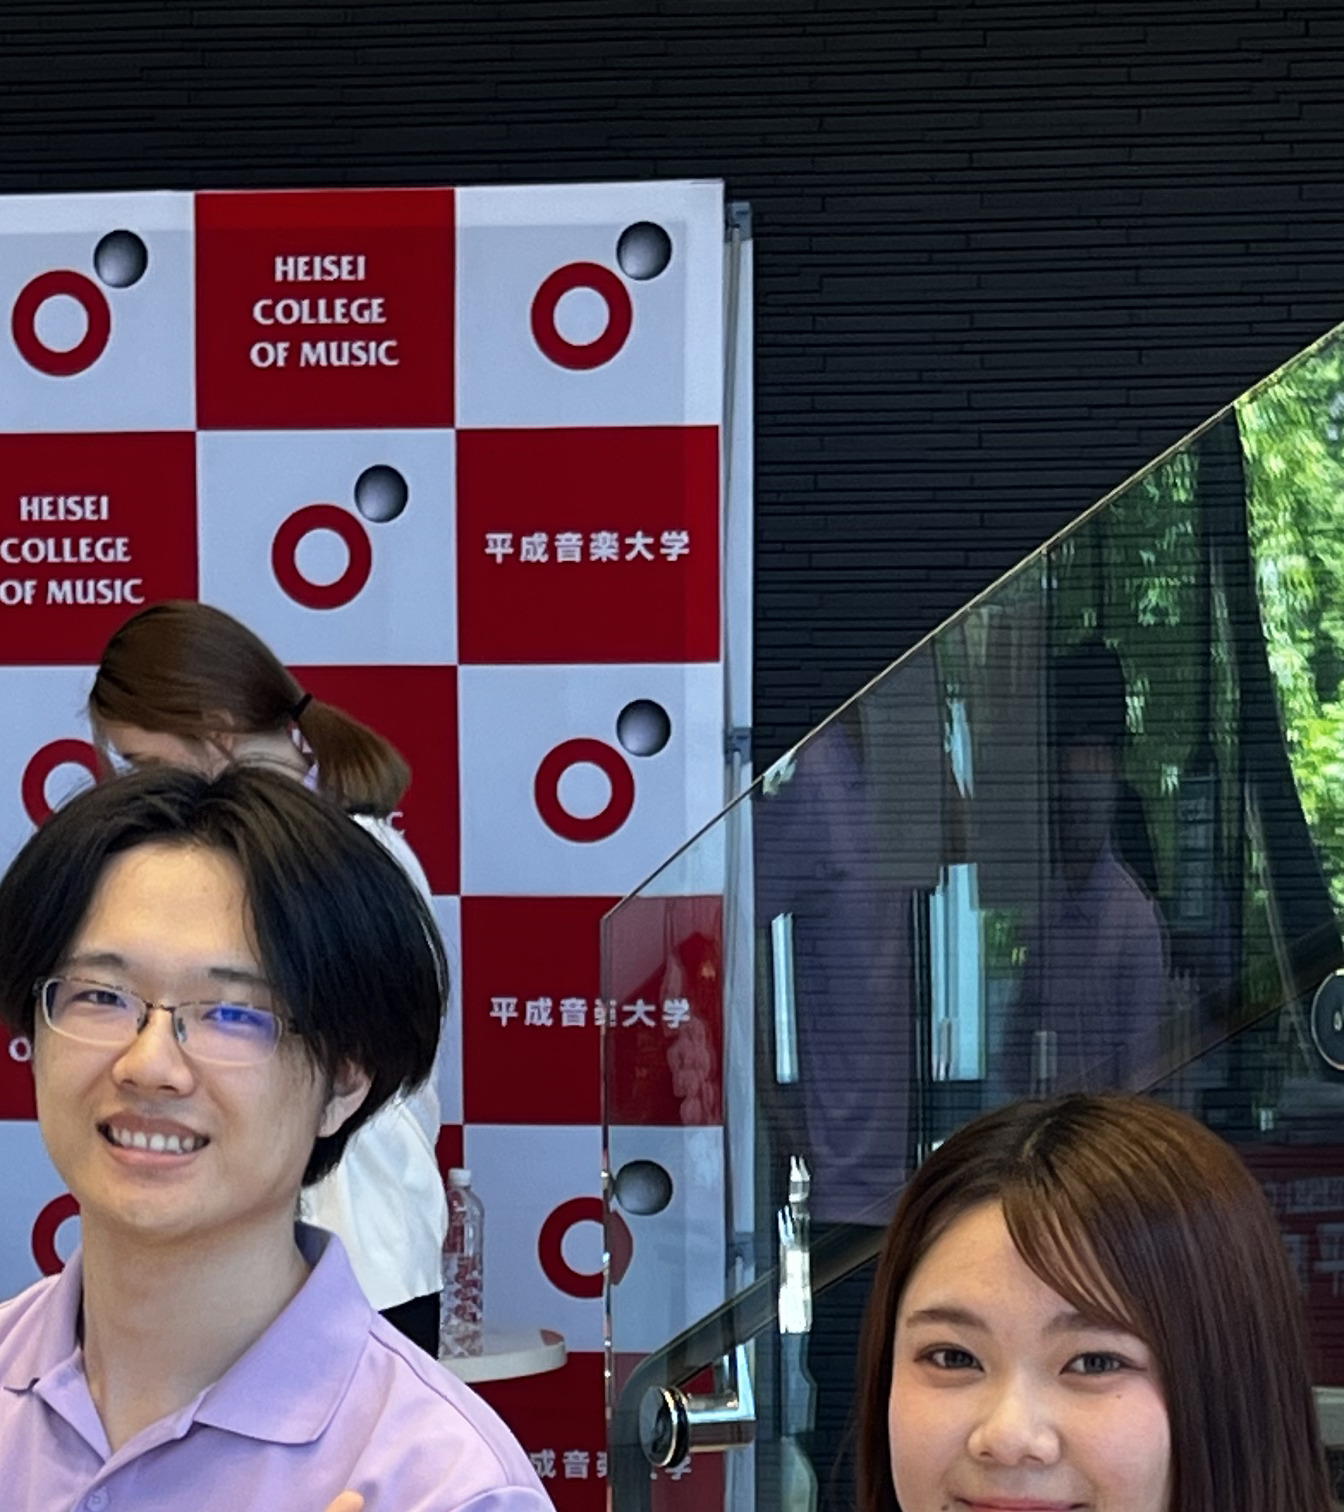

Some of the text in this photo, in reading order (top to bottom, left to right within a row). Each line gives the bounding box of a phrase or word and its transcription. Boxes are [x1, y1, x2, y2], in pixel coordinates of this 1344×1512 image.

[274, 255, 366, 282] HEISEI
[252, 297, 387, 325] COLLEGE
[249, 340, 399, 368] OF MUSIC
[19, 495, 109, 521] HEISEI
[0, 537, 132, 564] COLLEGE
[484, 530, 690, 564] 平成音楽大学
[46, 578, 145, 605] MUSIC
